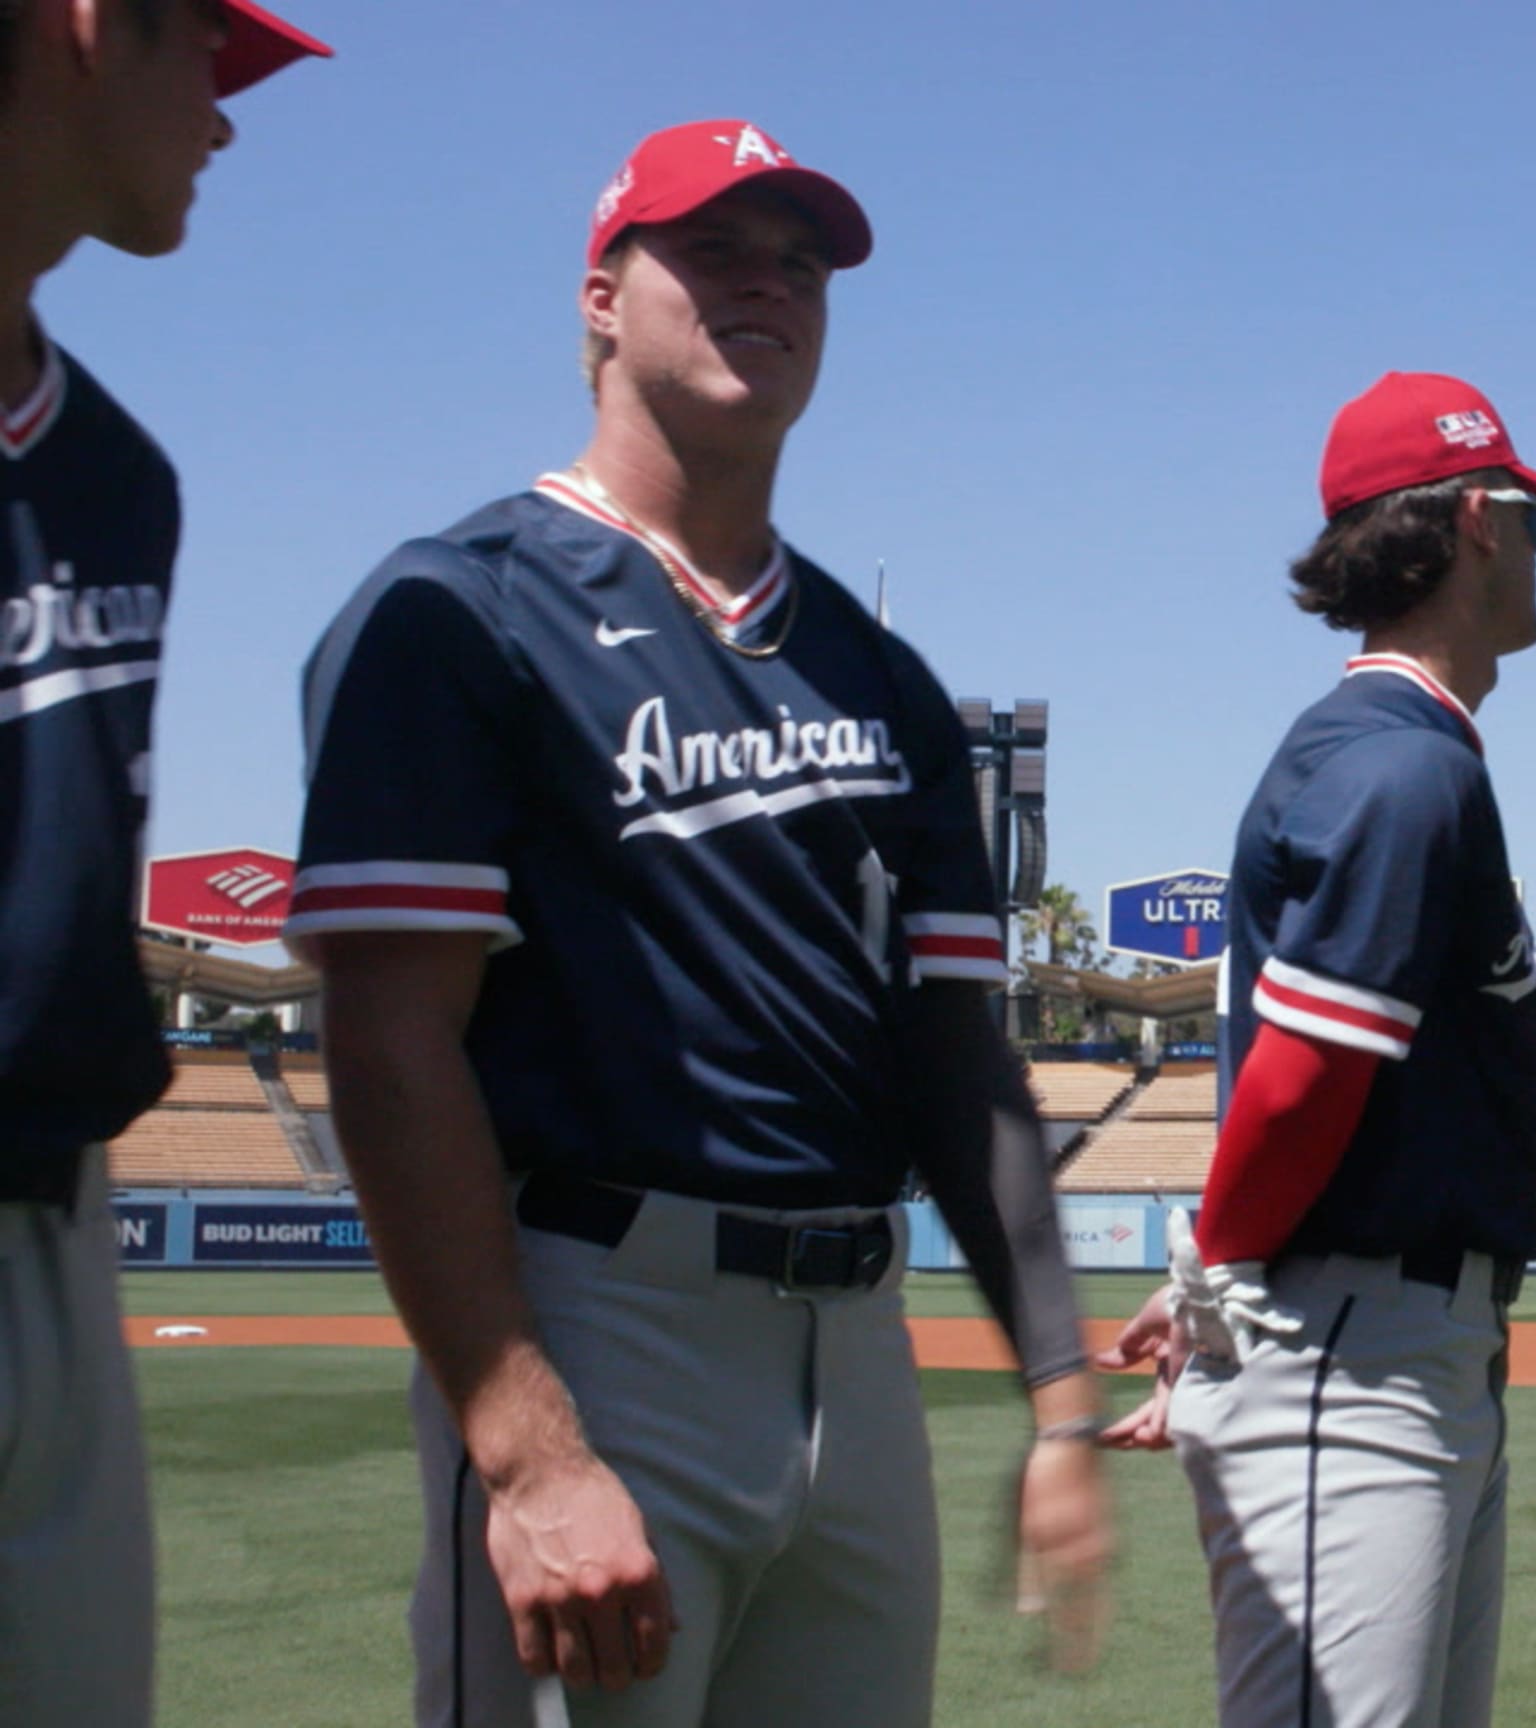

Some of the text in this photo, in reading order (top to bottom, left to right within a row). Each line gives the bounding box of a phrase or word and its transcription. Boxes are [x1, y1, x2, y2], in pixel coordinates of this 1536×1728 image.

[613, 695, 902, 808] American
[186, 913, 222, 924] BANK
[225, 914, 240, 925] OF
[1144, 898, 1226, 922] ULTR
[202, 1223, 252, 1243] BUD
[256, 1223, 322, 1243] LIGHT
